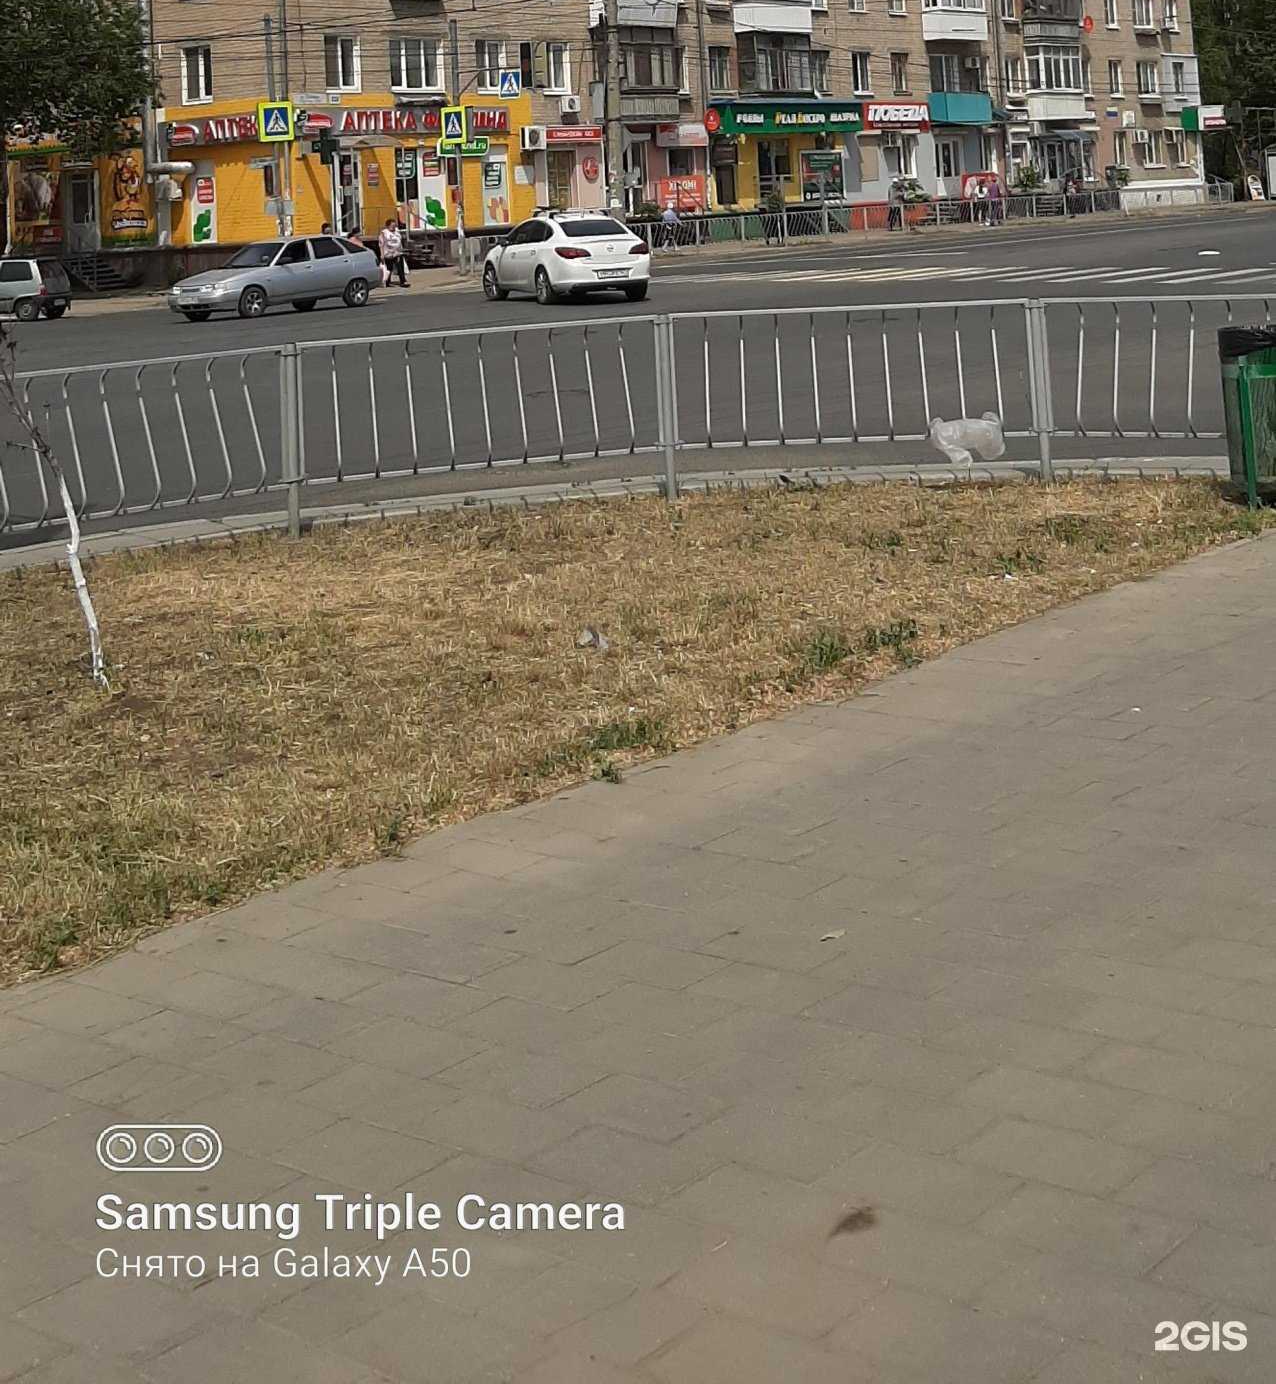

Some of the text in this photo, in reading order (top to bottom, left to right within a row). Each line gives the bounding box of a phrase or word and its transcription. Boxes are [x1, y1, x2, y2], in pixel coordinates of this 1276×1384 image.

[339, 110, 417, 131] АПТЕКА
[867, 104, 929, 121] ПОБЕДА
[203, 115, 258, 141] АПТЕК
